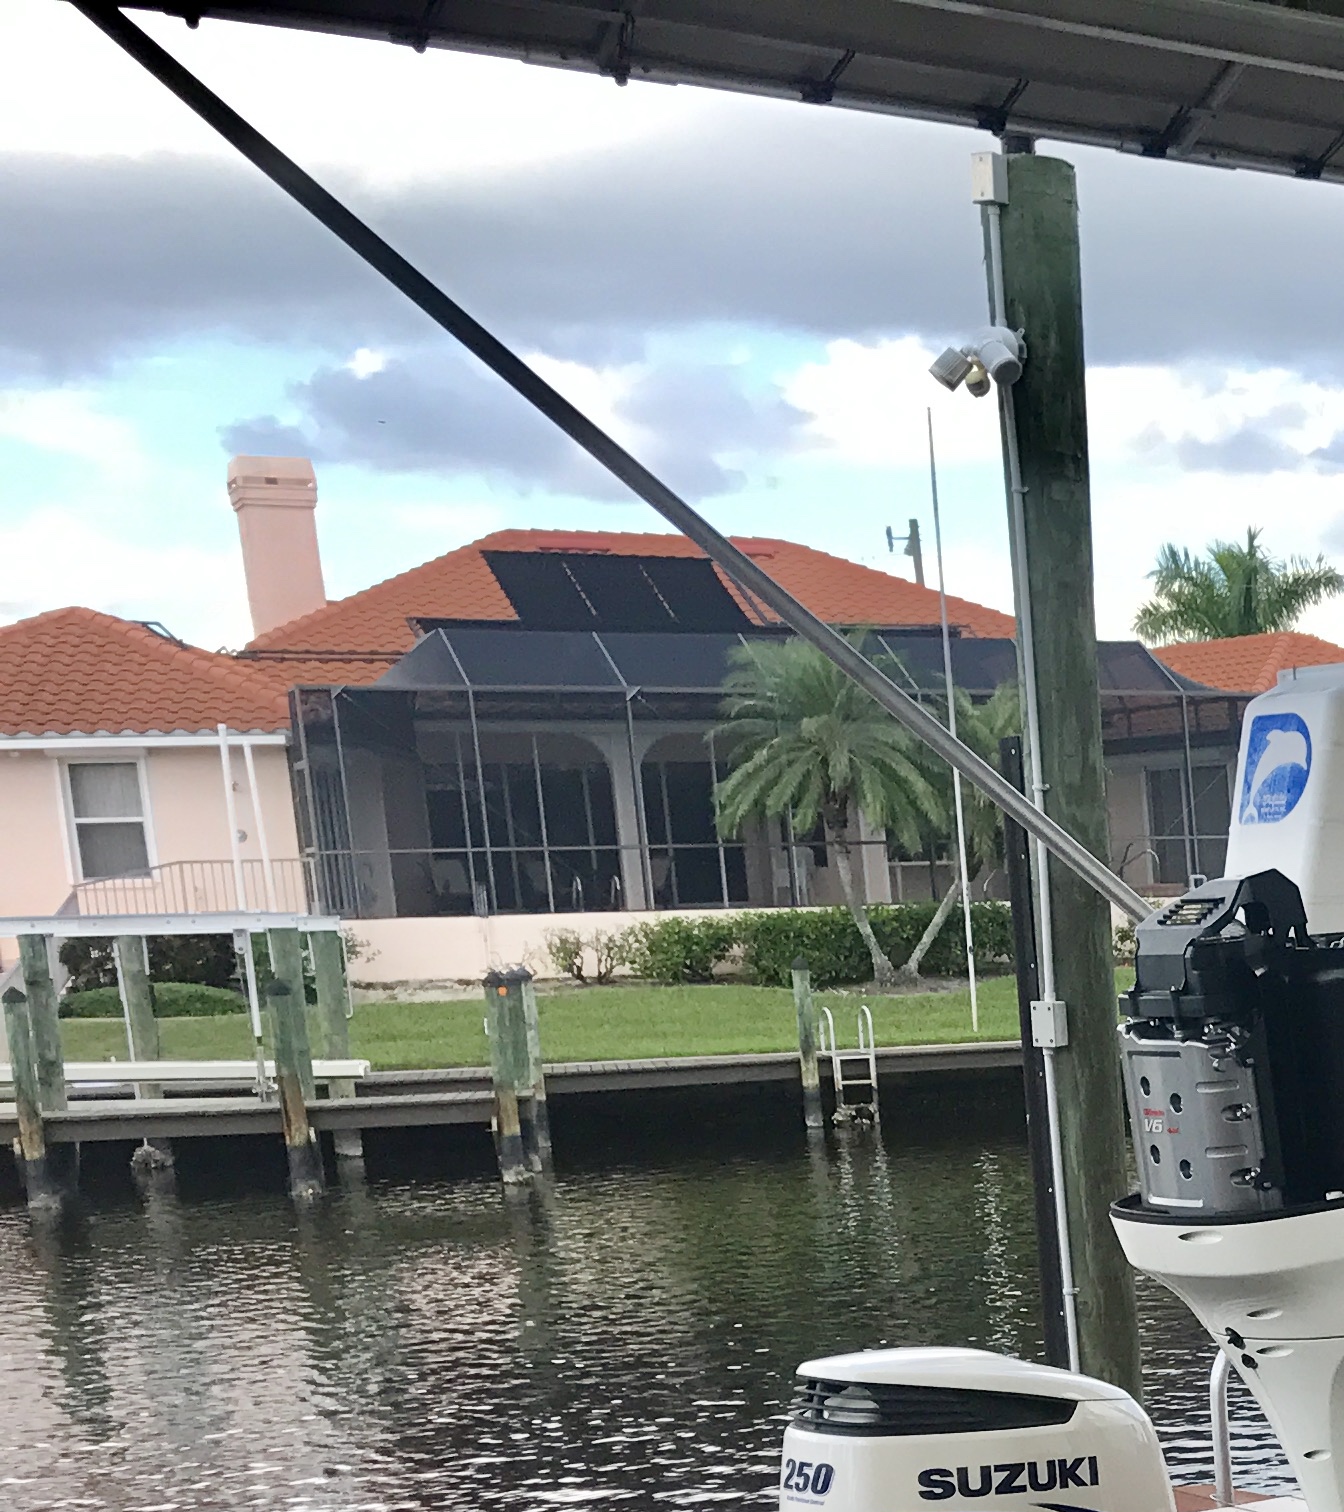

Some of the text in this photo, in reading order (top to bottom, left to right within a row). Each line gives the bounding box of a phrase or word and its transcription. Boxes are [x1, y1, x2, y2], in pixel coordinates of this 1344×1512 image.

[1144, 1118, 1163, 1133] V6
[783, 1458, 835, 1496] 250
[917, 1456, 1099, 1500] SUZUKI
